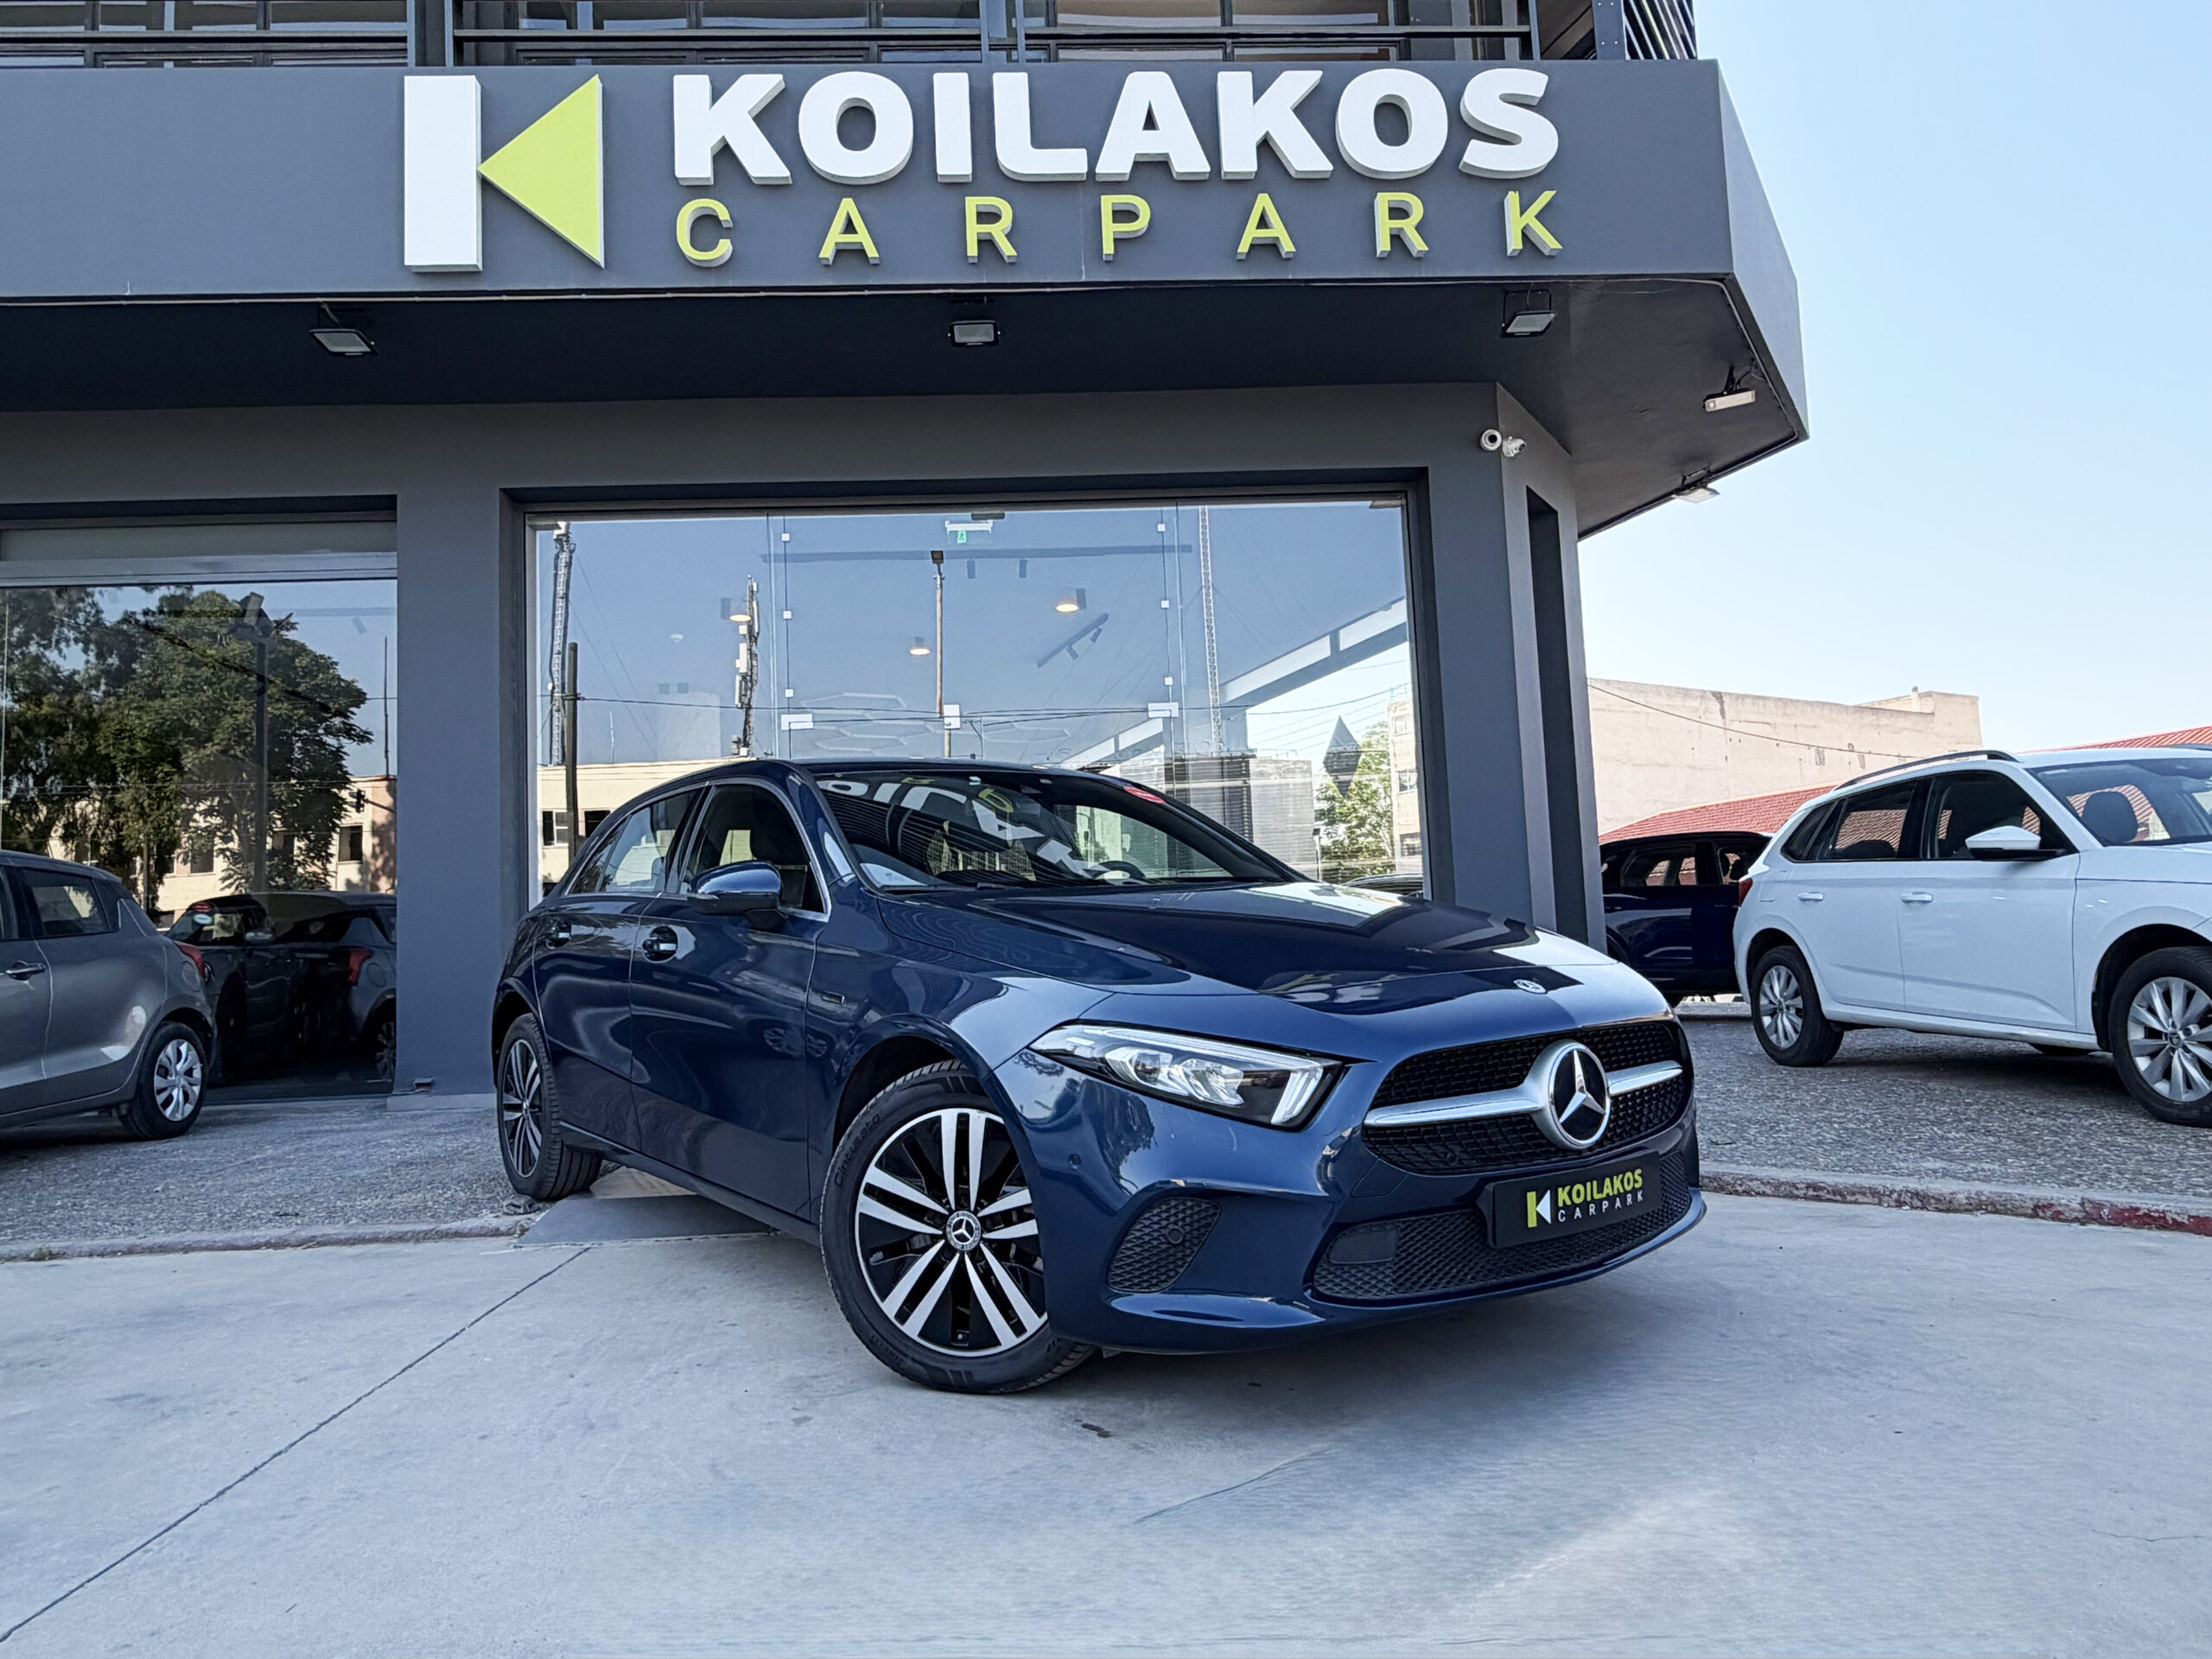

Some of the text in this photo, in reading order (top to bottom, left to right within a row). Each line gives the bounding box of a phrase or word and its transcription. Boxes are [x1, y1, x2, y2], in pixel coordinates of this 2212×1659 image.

[673, 67, 1559, 185] KOILAKOS
[677, 190, 1563, 267] CARPARK
[834, 1113, 880, 1188] Cinturato
[1558, 1168, 1643, 1207] KOILAKOS
[1558, 1190, 1643, 1223] CARPARK
